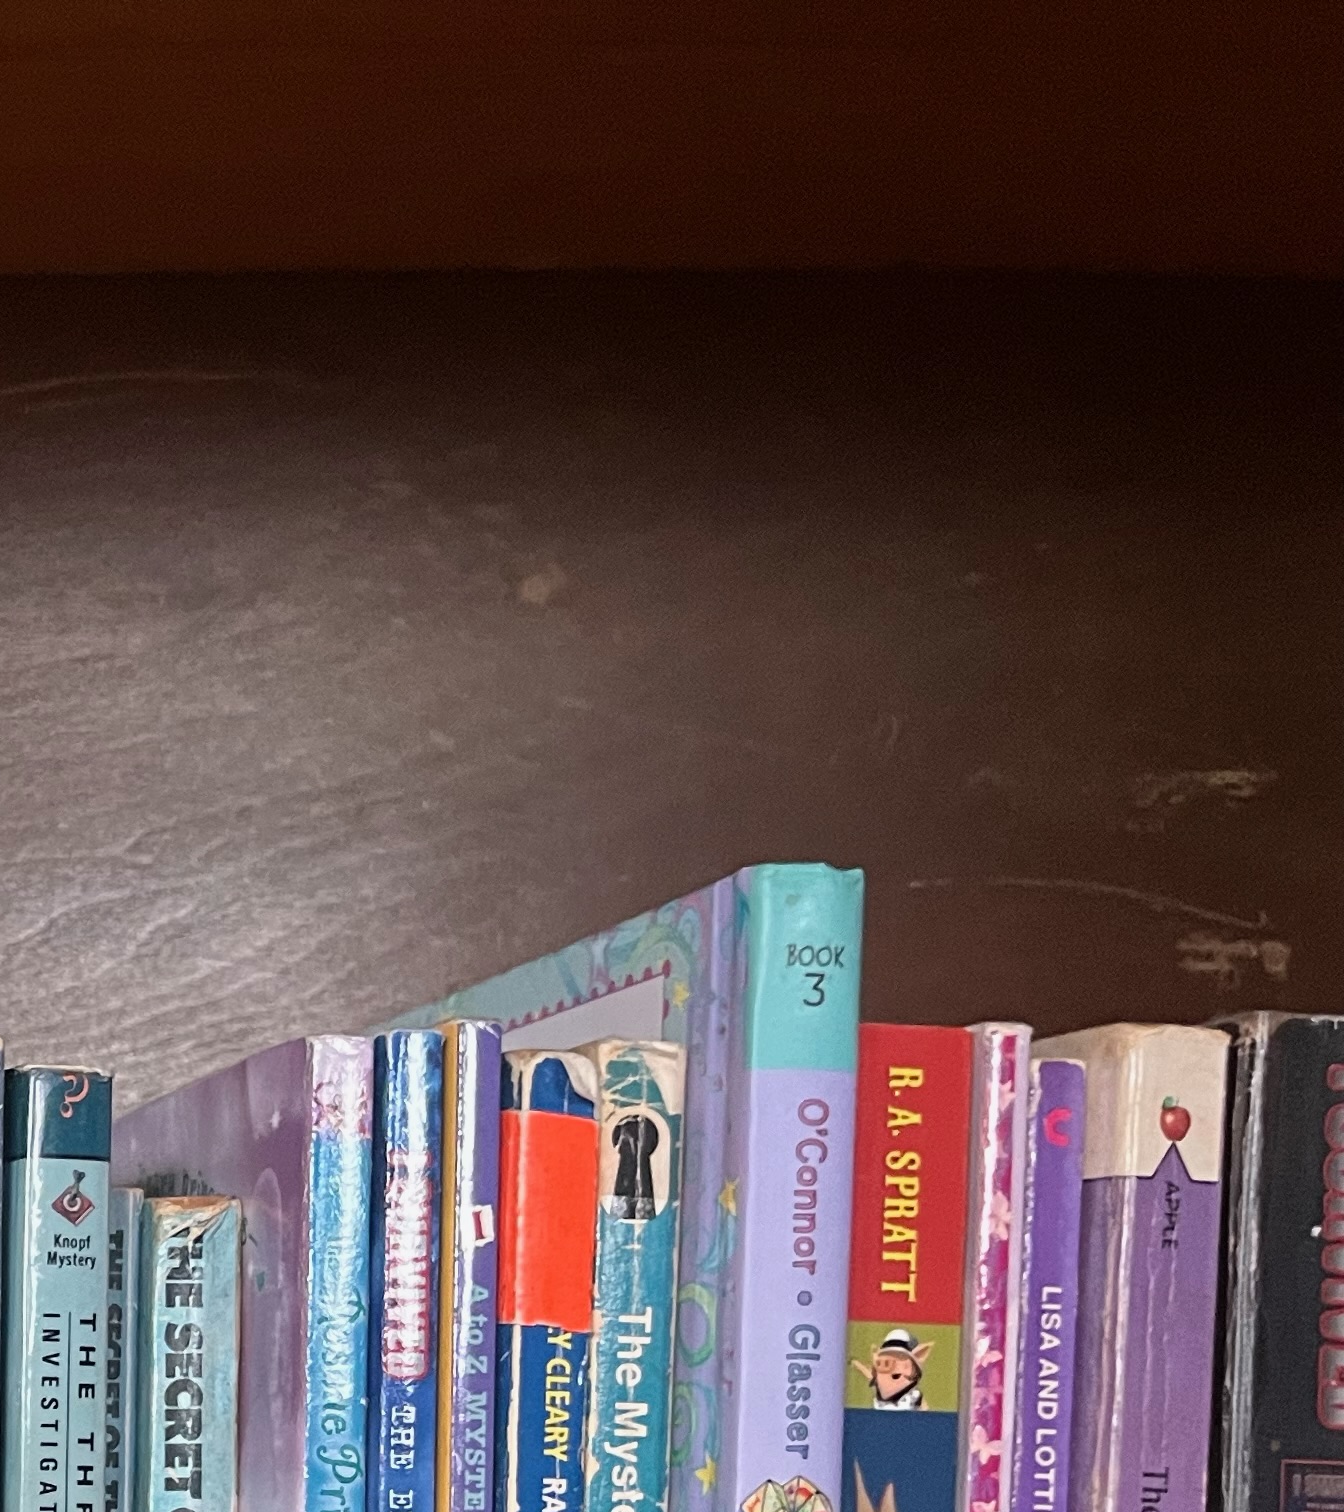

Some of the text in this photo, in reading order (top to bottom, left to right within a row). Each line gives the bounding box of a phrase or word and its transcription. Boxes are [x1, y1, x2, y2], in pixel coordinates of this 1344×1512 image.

[786, 945, 844, 967] BOOK
[803, 973, 826, 1005] 3
[785, 1100, 829, 1460] O'Connor Glasser
[615, 1307, 652, 1386] The
[1038, 1286, 1062, 1350] LISA
[78, 1313, 96, 1398] THE
[1036, 1359, 1059, 1419] AND
[544, 1359, 570, 1461] CLEARY
